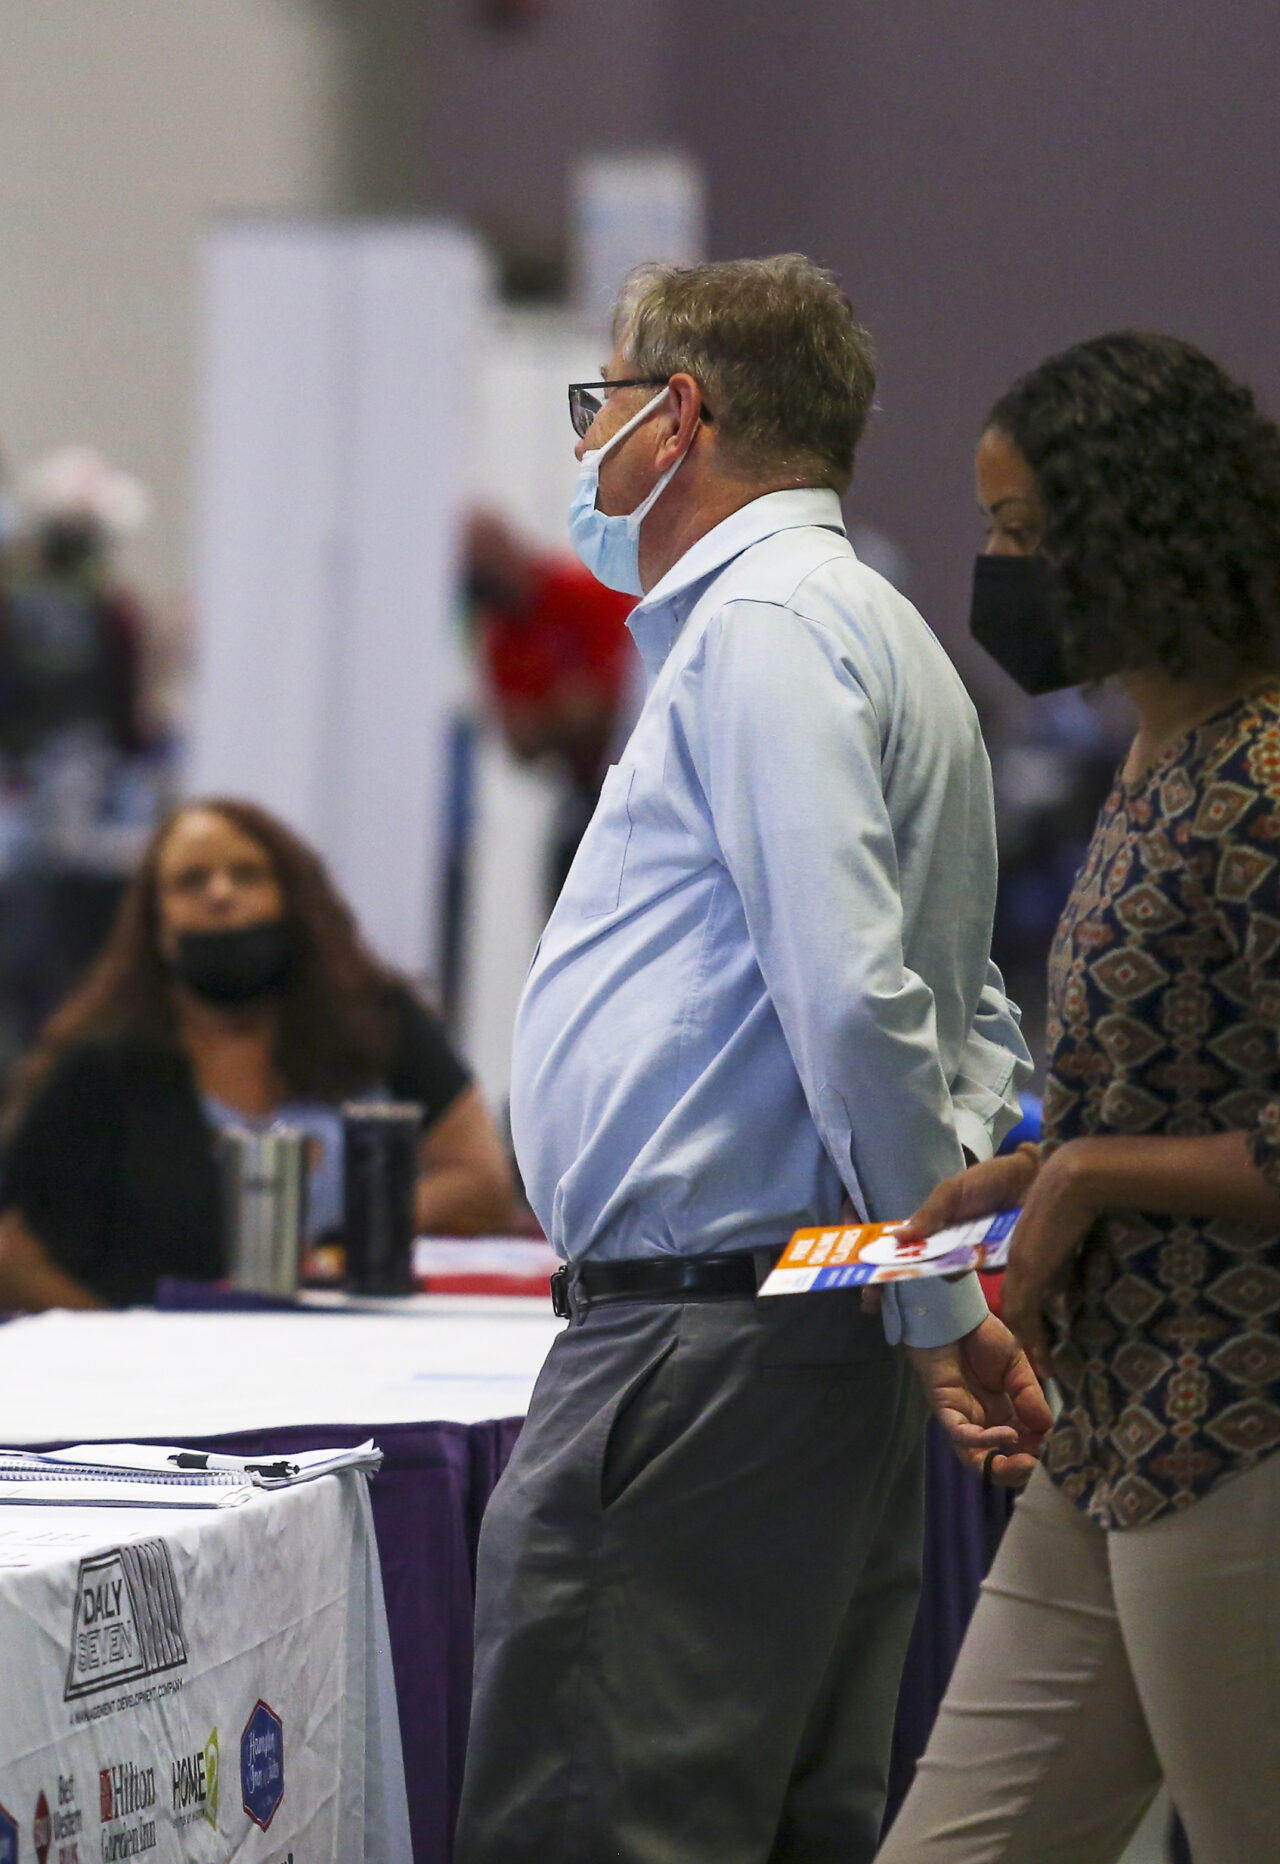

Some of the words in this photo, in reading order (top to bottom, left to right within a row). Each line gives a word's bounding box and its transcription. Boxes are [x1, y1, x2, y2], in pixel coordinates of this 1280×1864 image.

[83, 1578, 123, 1626] DALY
[77, 1619, 133, 1673] SEVEN
[158, 1677, 183, 1698] COMPANY
[112, 1761, 156, 1819] Hilton
